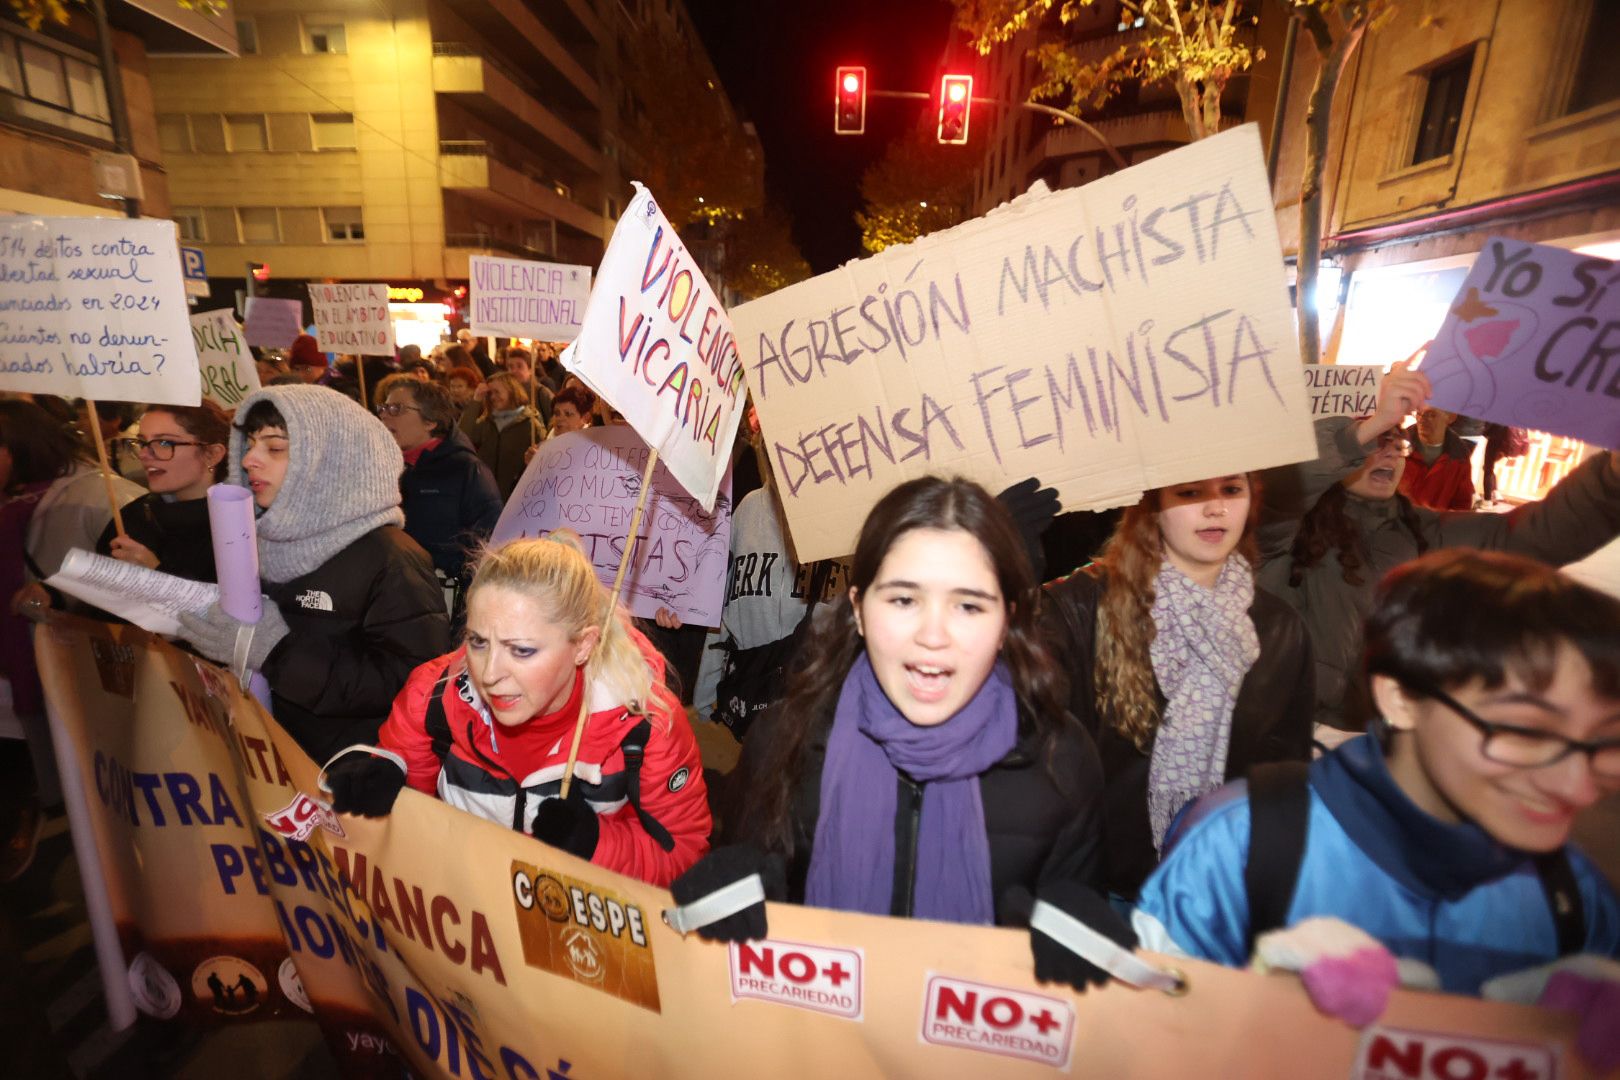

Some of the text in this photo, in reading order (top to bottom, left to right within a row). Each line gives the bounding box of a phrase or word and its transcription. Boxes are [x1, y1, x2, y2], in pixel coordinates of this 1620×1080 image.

[92, 237, 156, 257] contra
[67, 258, 153, 283] sexual
[473, 261, 563, 292] VIOLENCIA
[751, 178, 1264, 399] AGRESIÓN MACHISTA
[82, 298, 104, 311] en
[315, 309, 330, 325] EN
[476, 297, 582, 326] INSTITUCIONAL
[641, 225, 745, 411] VIOLENCIA
[70, 332, 92, 345] no
[320, 330, 387, 346] EDUCATIVO
[619, 295, 722, 456] VICARIA
[774, 308, 1286, 498] DEFENSA FEMINISTA
[1311, 390, 1377, 416] TÉTRICA
[523, 475, 574, 499] COMO
[558, 502, 594, 523] NOS
[738, 943, 851, 987] NO+
[738, 976, 853, 1008] PRECARIEDAD
[936, 986, 1061, 1036] NO+
[932, 1022, 1059, 1059] PRECARIEDAD
